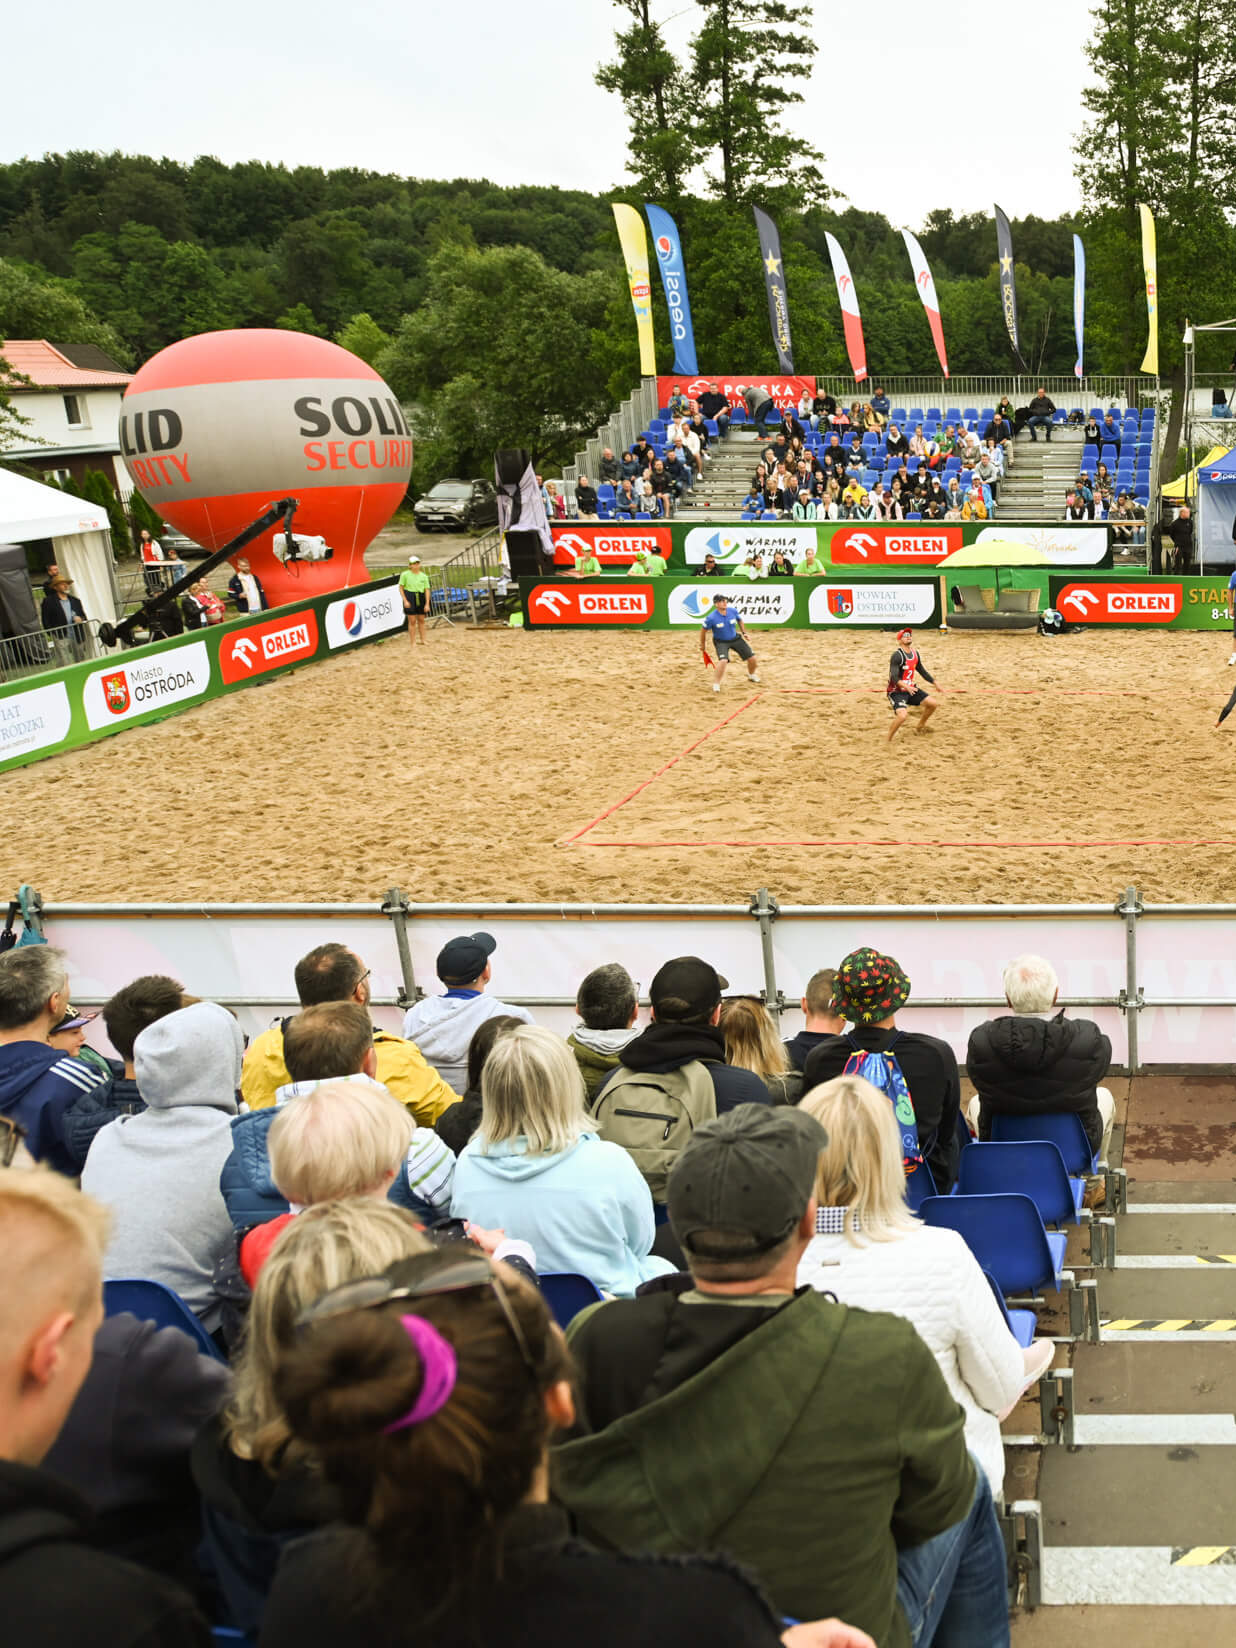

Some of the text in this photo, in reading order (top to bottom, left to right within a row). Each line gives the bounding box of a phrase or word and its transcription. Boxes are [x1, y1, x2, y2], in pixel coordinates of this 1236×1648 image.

[724, 384, 794, 396] POSKA
[303, 439, 412, 472] SECURIT
[130, 452, 193, 490] RITY
[599, 540, 653, 552] ORLEN
[746, 537, 797, 546] WARMIA
[889, 539, 943, 552] ORLEN
[857, 591, 896, 600] POWIAT
[1189, 588, 1235, 604] STAR
[584, 597, 642, 610] ORLEN
[1111, 597, 1170, 610] ORLEN
[363, 598, 393, 624] pepsi
[736, 606, 782, 615] AZURY
[266, 628, 306, 654] ORLEN
[131, 665, 163, 683] Miasto
[134, 671, 195, 702] OSTRÓDA
